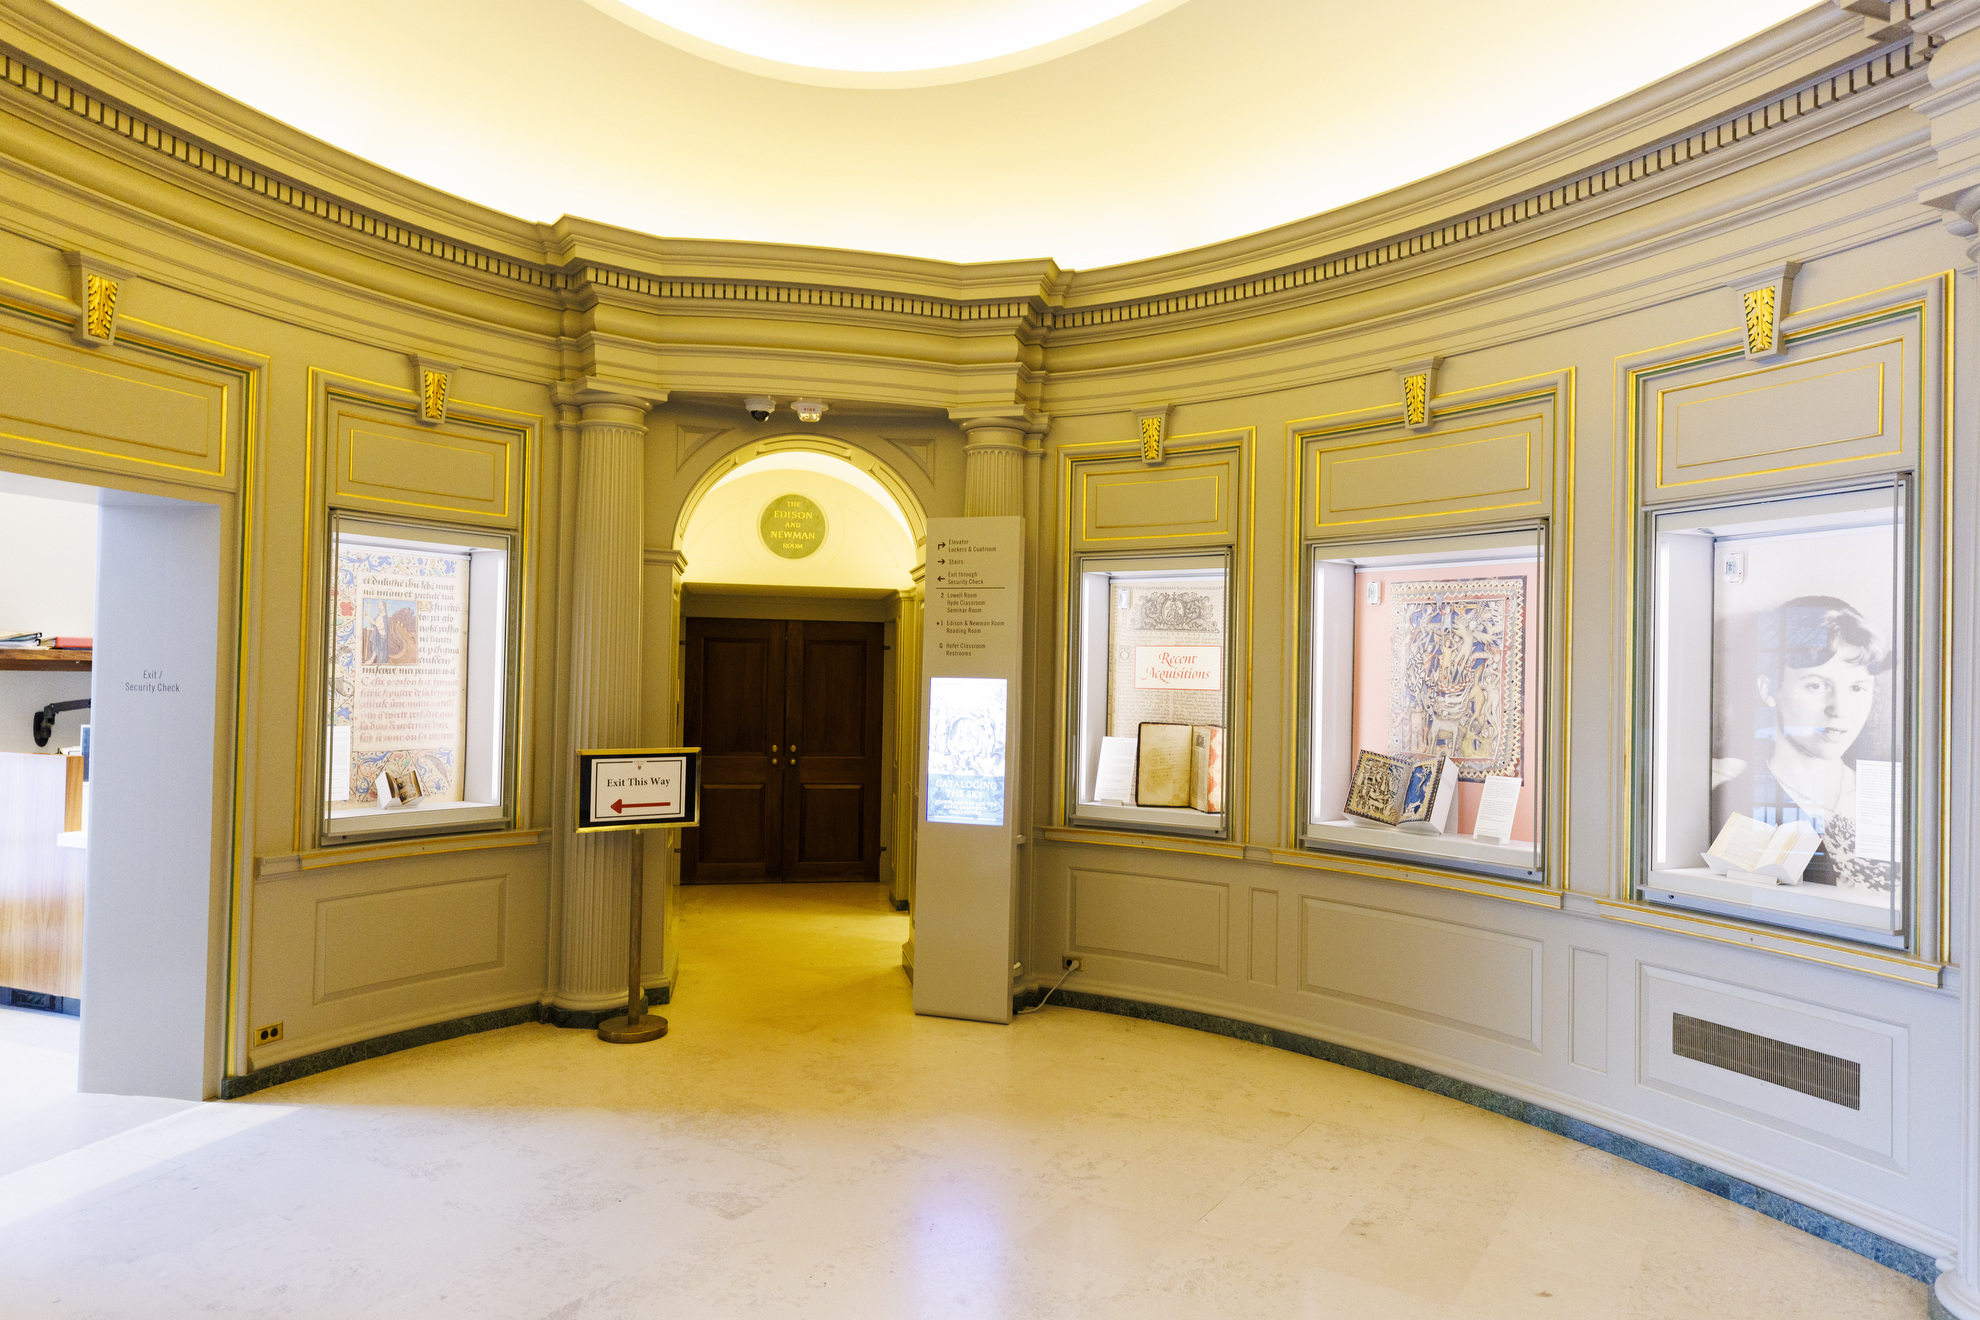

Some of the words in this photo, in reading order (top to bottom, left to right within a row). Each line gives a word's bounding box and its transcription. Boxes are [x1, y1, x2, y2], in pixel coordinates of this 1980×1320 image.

[774, 510, 812, 519] EDISON
[771, 531, 815, 540] NEWMAN
[1158, 652, 1198, 668] Recent
[143, 670, 156, 679] Exit
[1141, 666, 1211, 684] Acquisitions
[125, 682, 155, 693] Security
[158, 683, 180, 692] Check
[607, 778, 625, 787] Exit
[628, 777, 648, 786] This
[651, 777, 670, 787] Way
[936, 779, 997, 790] CATALOGING
[946, 789, 964, 797] THE
[967, 790, 984, 799] SKY
